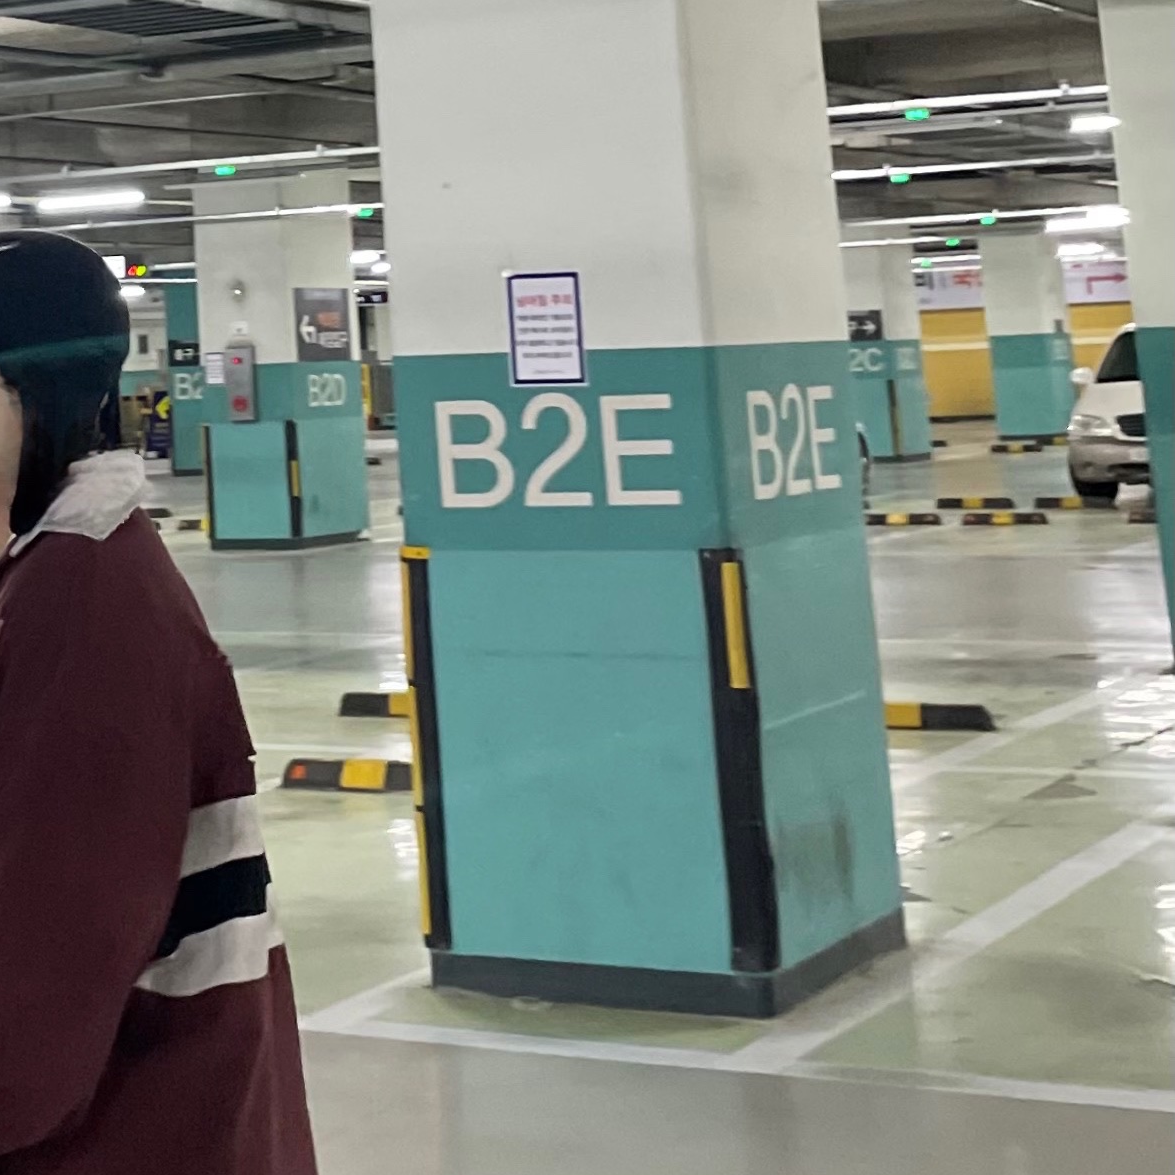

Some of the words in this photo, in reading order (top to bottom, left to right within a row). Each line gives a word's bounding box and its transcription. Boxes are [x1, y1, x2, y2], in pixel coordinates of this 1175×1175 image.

[307, 372, 346, 407] B2D
[746, 382, 842, 501] B2E
[434, 392, 683, 509] B2E
